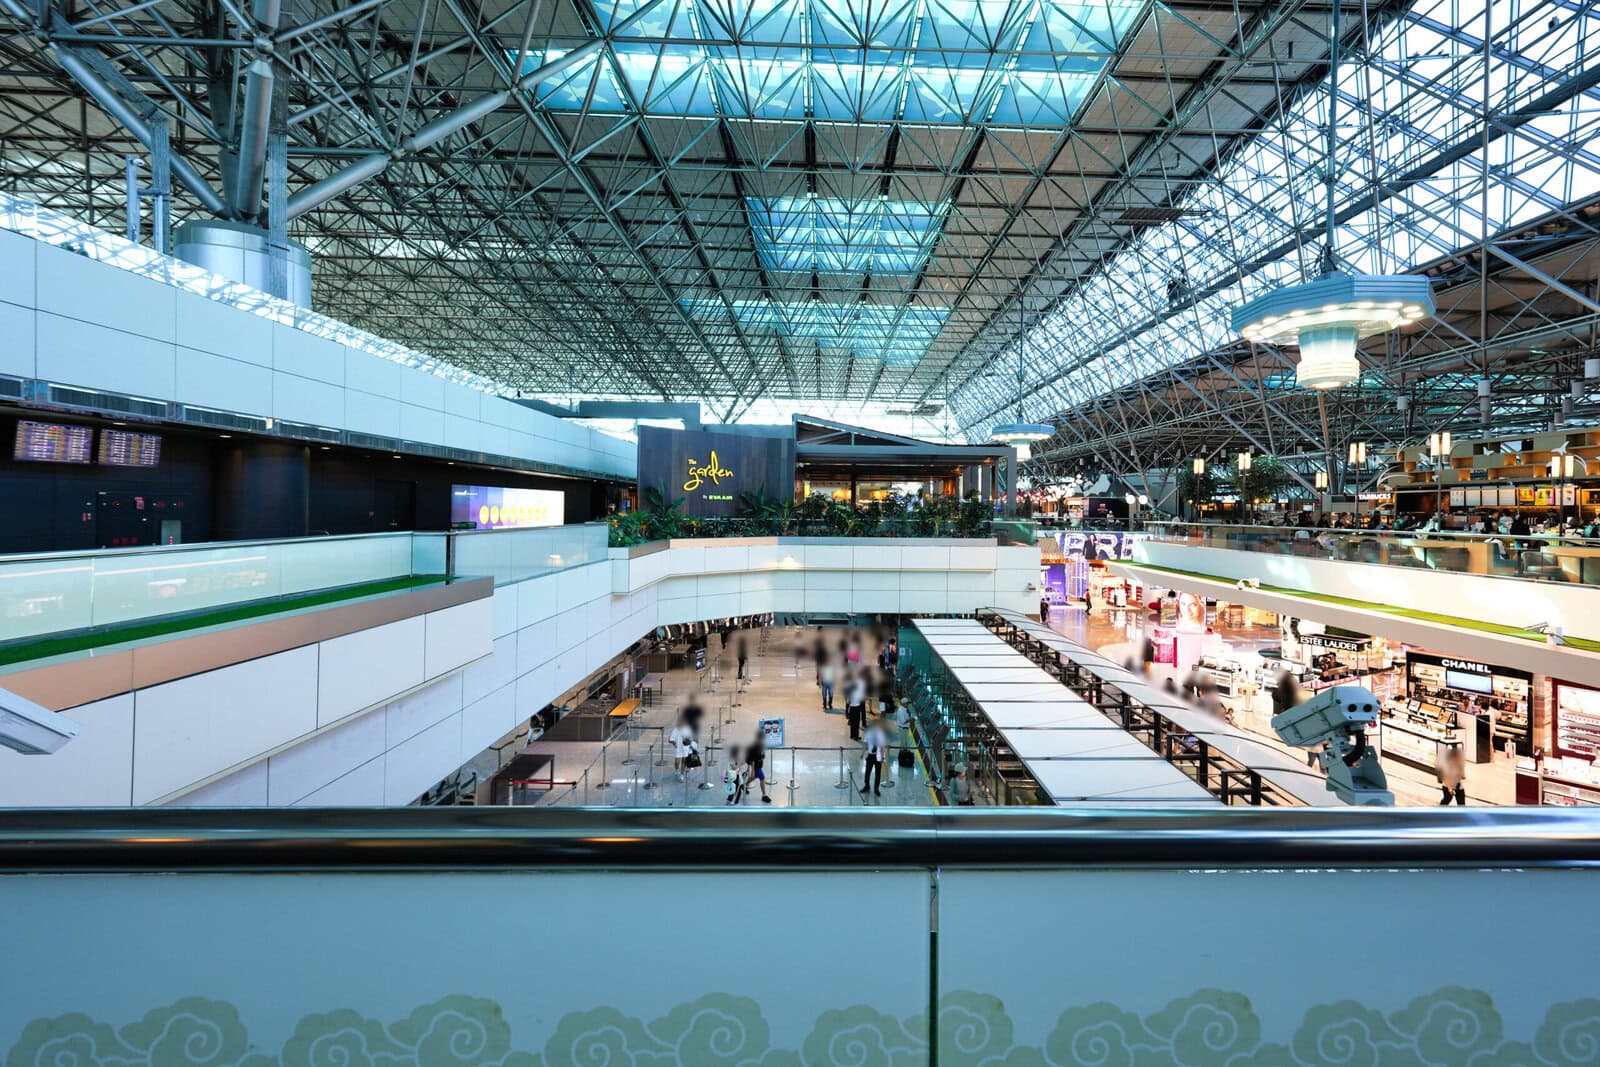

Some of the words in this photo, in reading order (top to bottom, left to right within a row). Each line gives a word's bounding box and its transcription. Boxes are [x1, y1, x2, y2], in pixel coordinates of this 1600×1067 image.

[683, 451, 733, 490] garden
[1323, 640, 1358, 652] LAUDER
[1441, 659, 1491, 673] CHANEL
